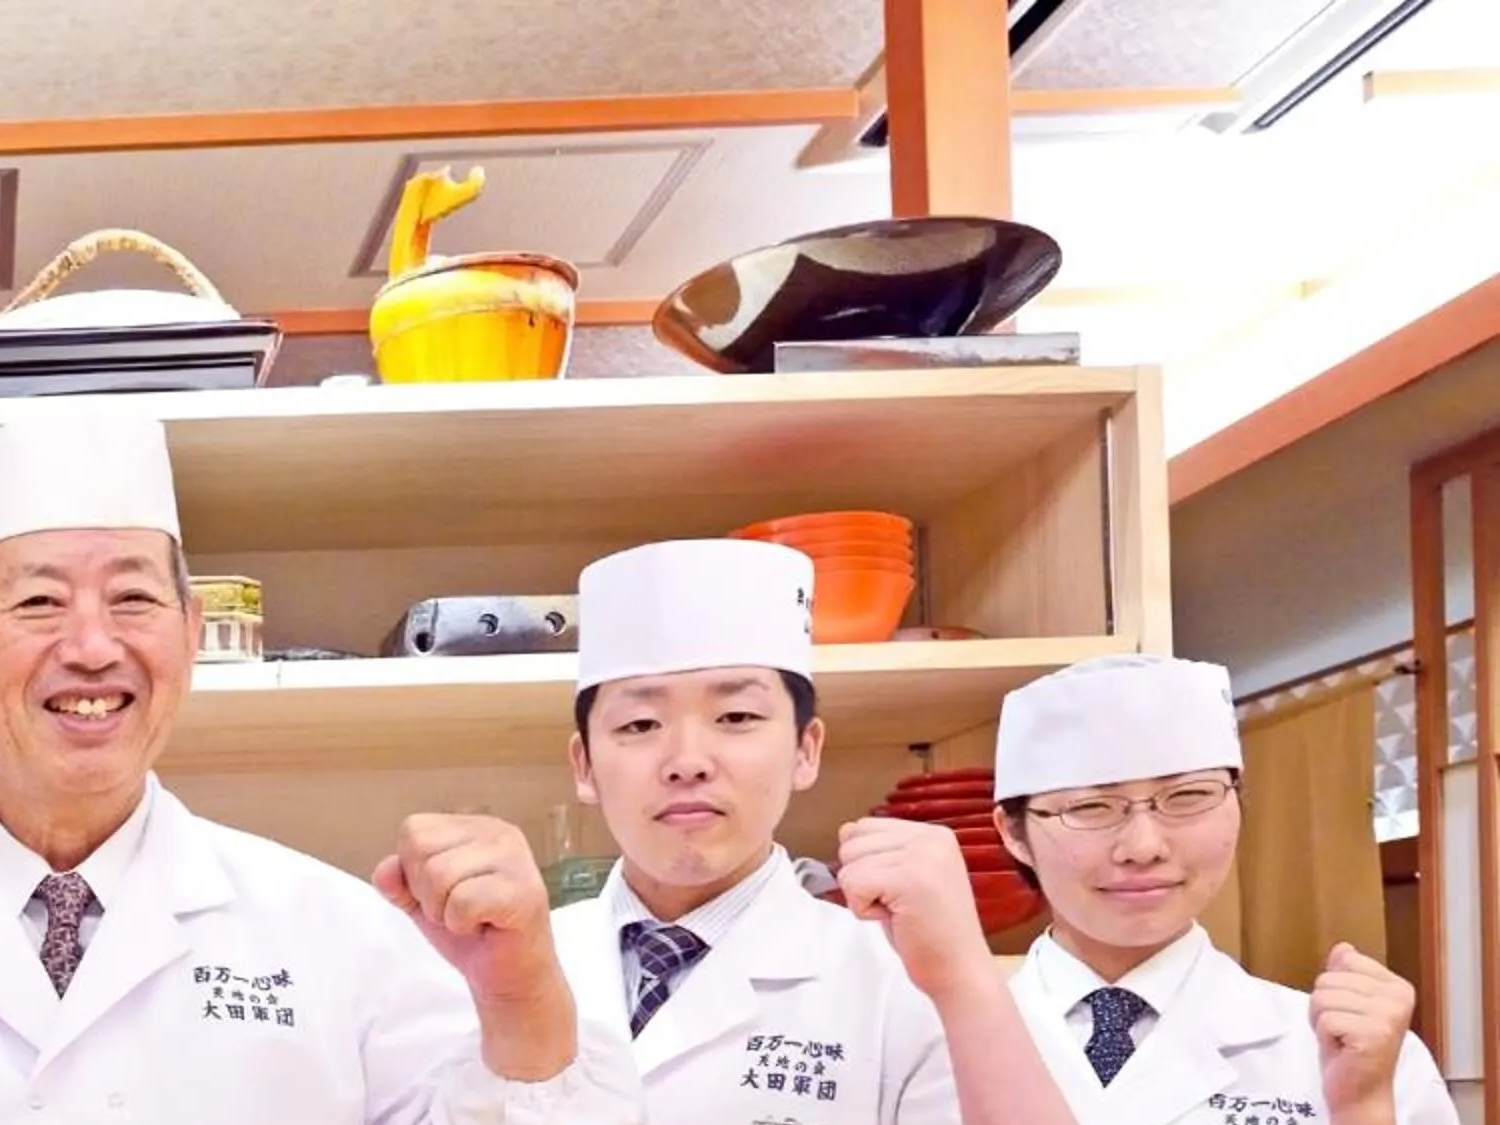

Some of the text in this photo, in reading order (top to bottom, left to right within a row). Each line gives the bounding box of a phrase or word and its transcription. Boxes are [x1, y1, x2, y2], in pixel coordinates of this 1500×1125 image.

[202, 1000, 295, 1027] 大田軍団
[740, 1067, 837, 1101] 大田軍団
